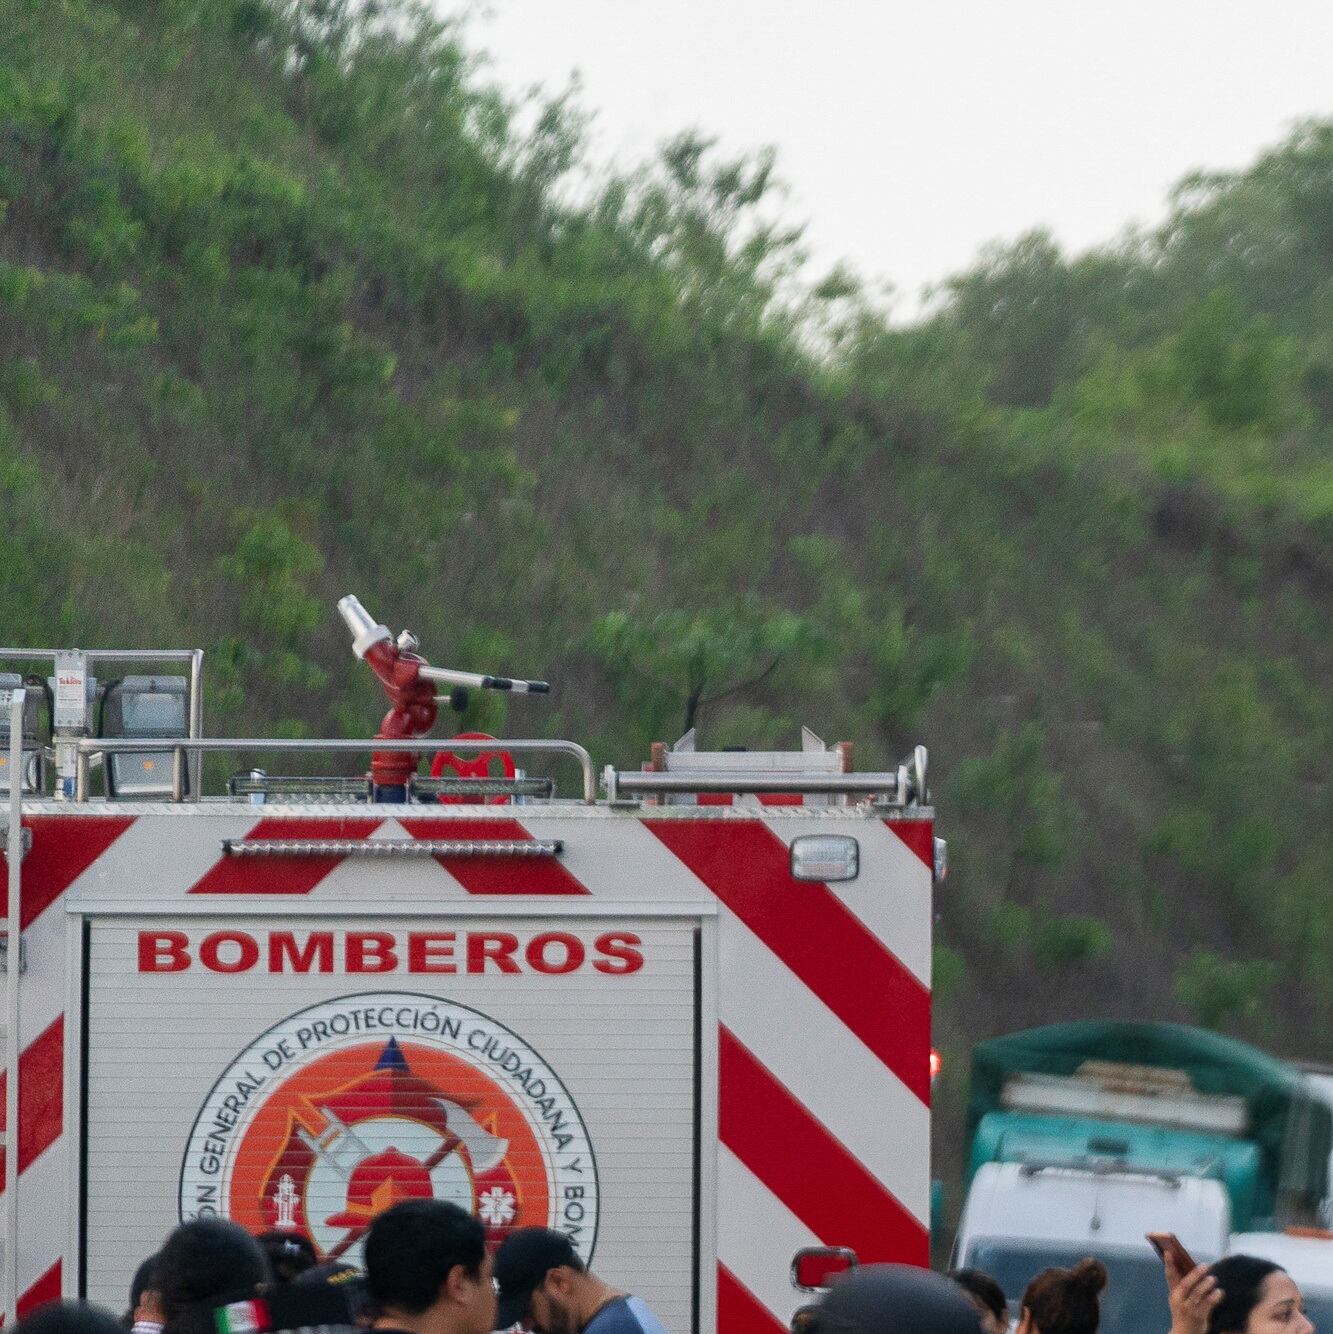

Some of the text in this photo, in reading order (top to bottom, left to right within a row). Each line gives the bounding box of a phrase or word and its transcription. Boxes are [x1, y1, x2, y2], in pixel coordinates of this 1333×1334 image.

[137, 930, 646, 976] BOMBEROS
[297, 1005, 462, 1049] PROTECCIÓN
[262, 1039, 297, 1071] DE
[467, 1029, 574, 1151] CIUDADANA
[200, 1071, 267, 1175] GENERAL
[561, 1158, 582, 1174] Y
[563, 1185, 585, 1248] BOM
